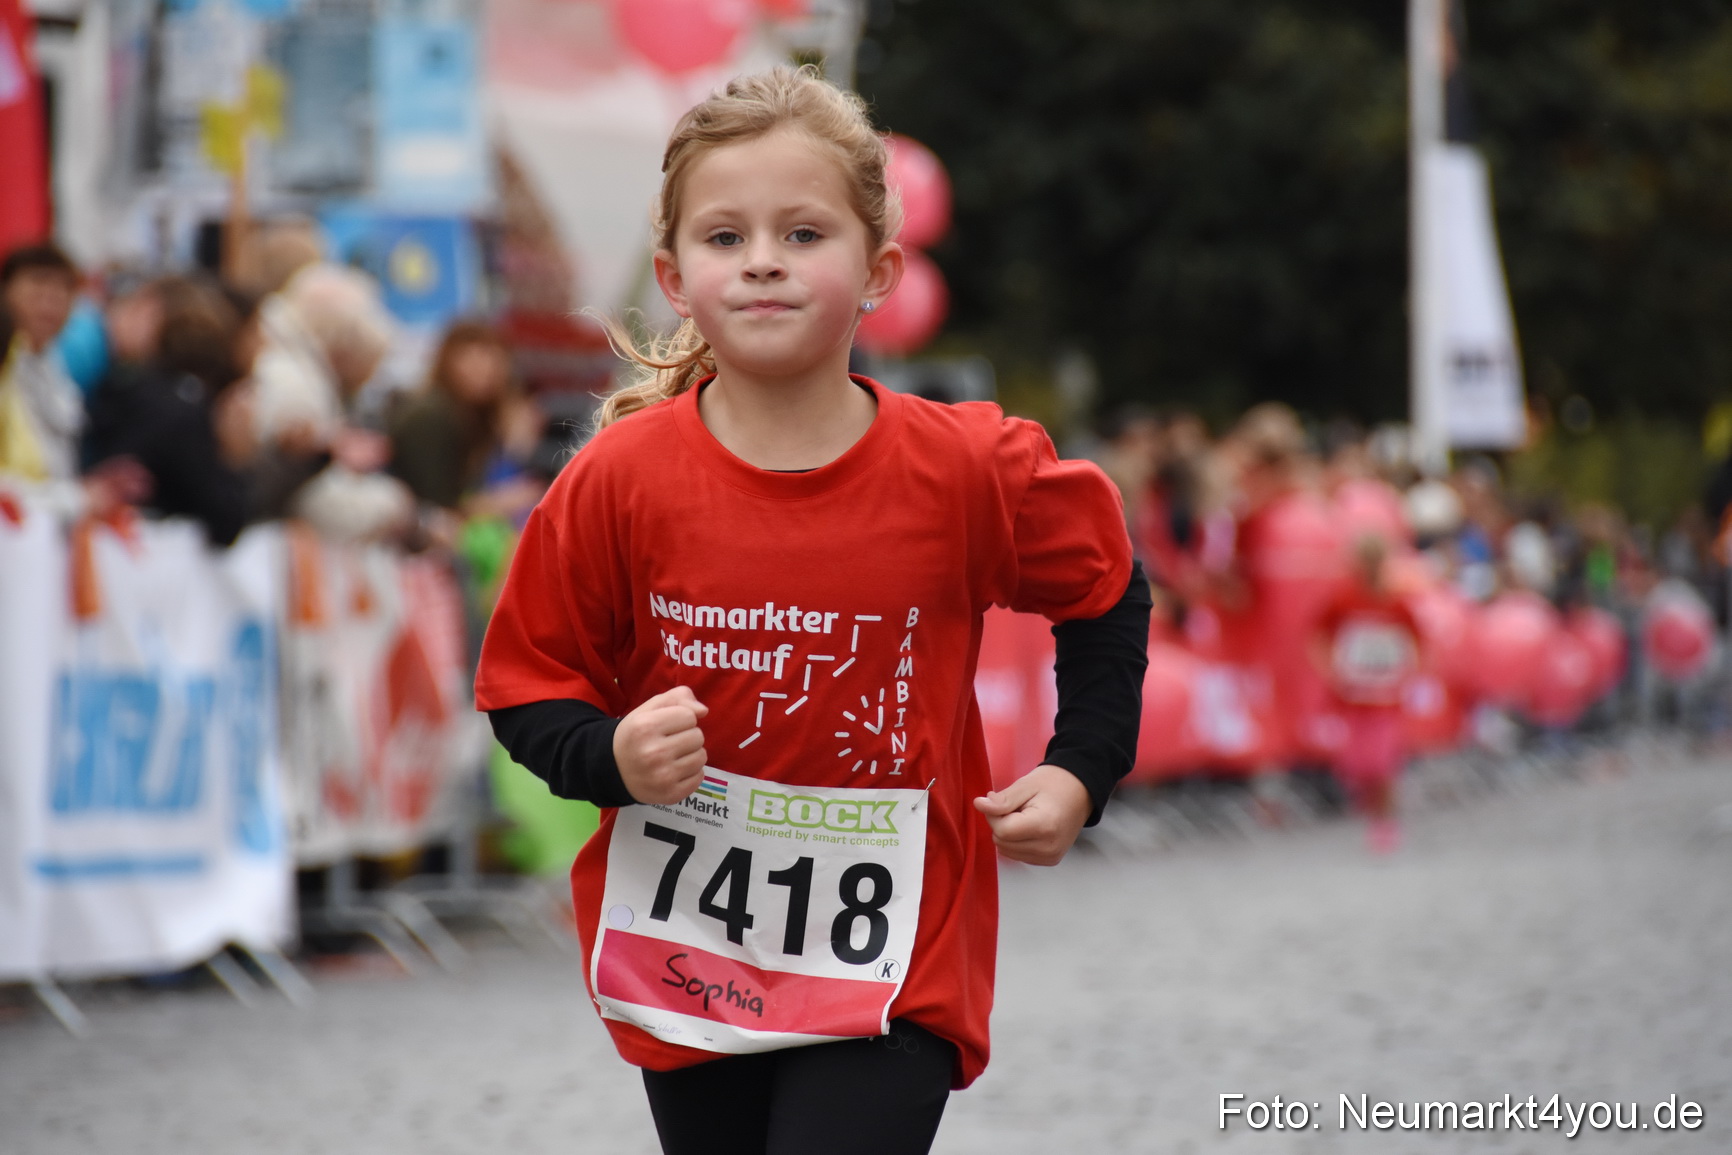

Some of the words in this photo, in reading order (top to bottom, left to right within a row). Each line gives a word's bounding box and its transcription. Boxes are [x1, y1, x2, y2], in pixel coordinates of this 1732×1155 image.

[650, 591, 839, 634] Neumarkter
[660, 629, 794, 680] Stdtlauf
[889, 607, 919, 775] BAMBINI
[675, 809, 692, 820] leben
[695, 816, 723, 829] genießen
[748, 789, 899, 834] BOCK
[745, 822, 792, 839] inspired
[795, 828, 809, 841] by
[812, 834, 846, 845] smart
[850, 837, 899, 848] concepts
[643, 821, 893, 965] 7418
[661, 953, 764, 1018] Sophia
[881, 962, 894, 978] K
